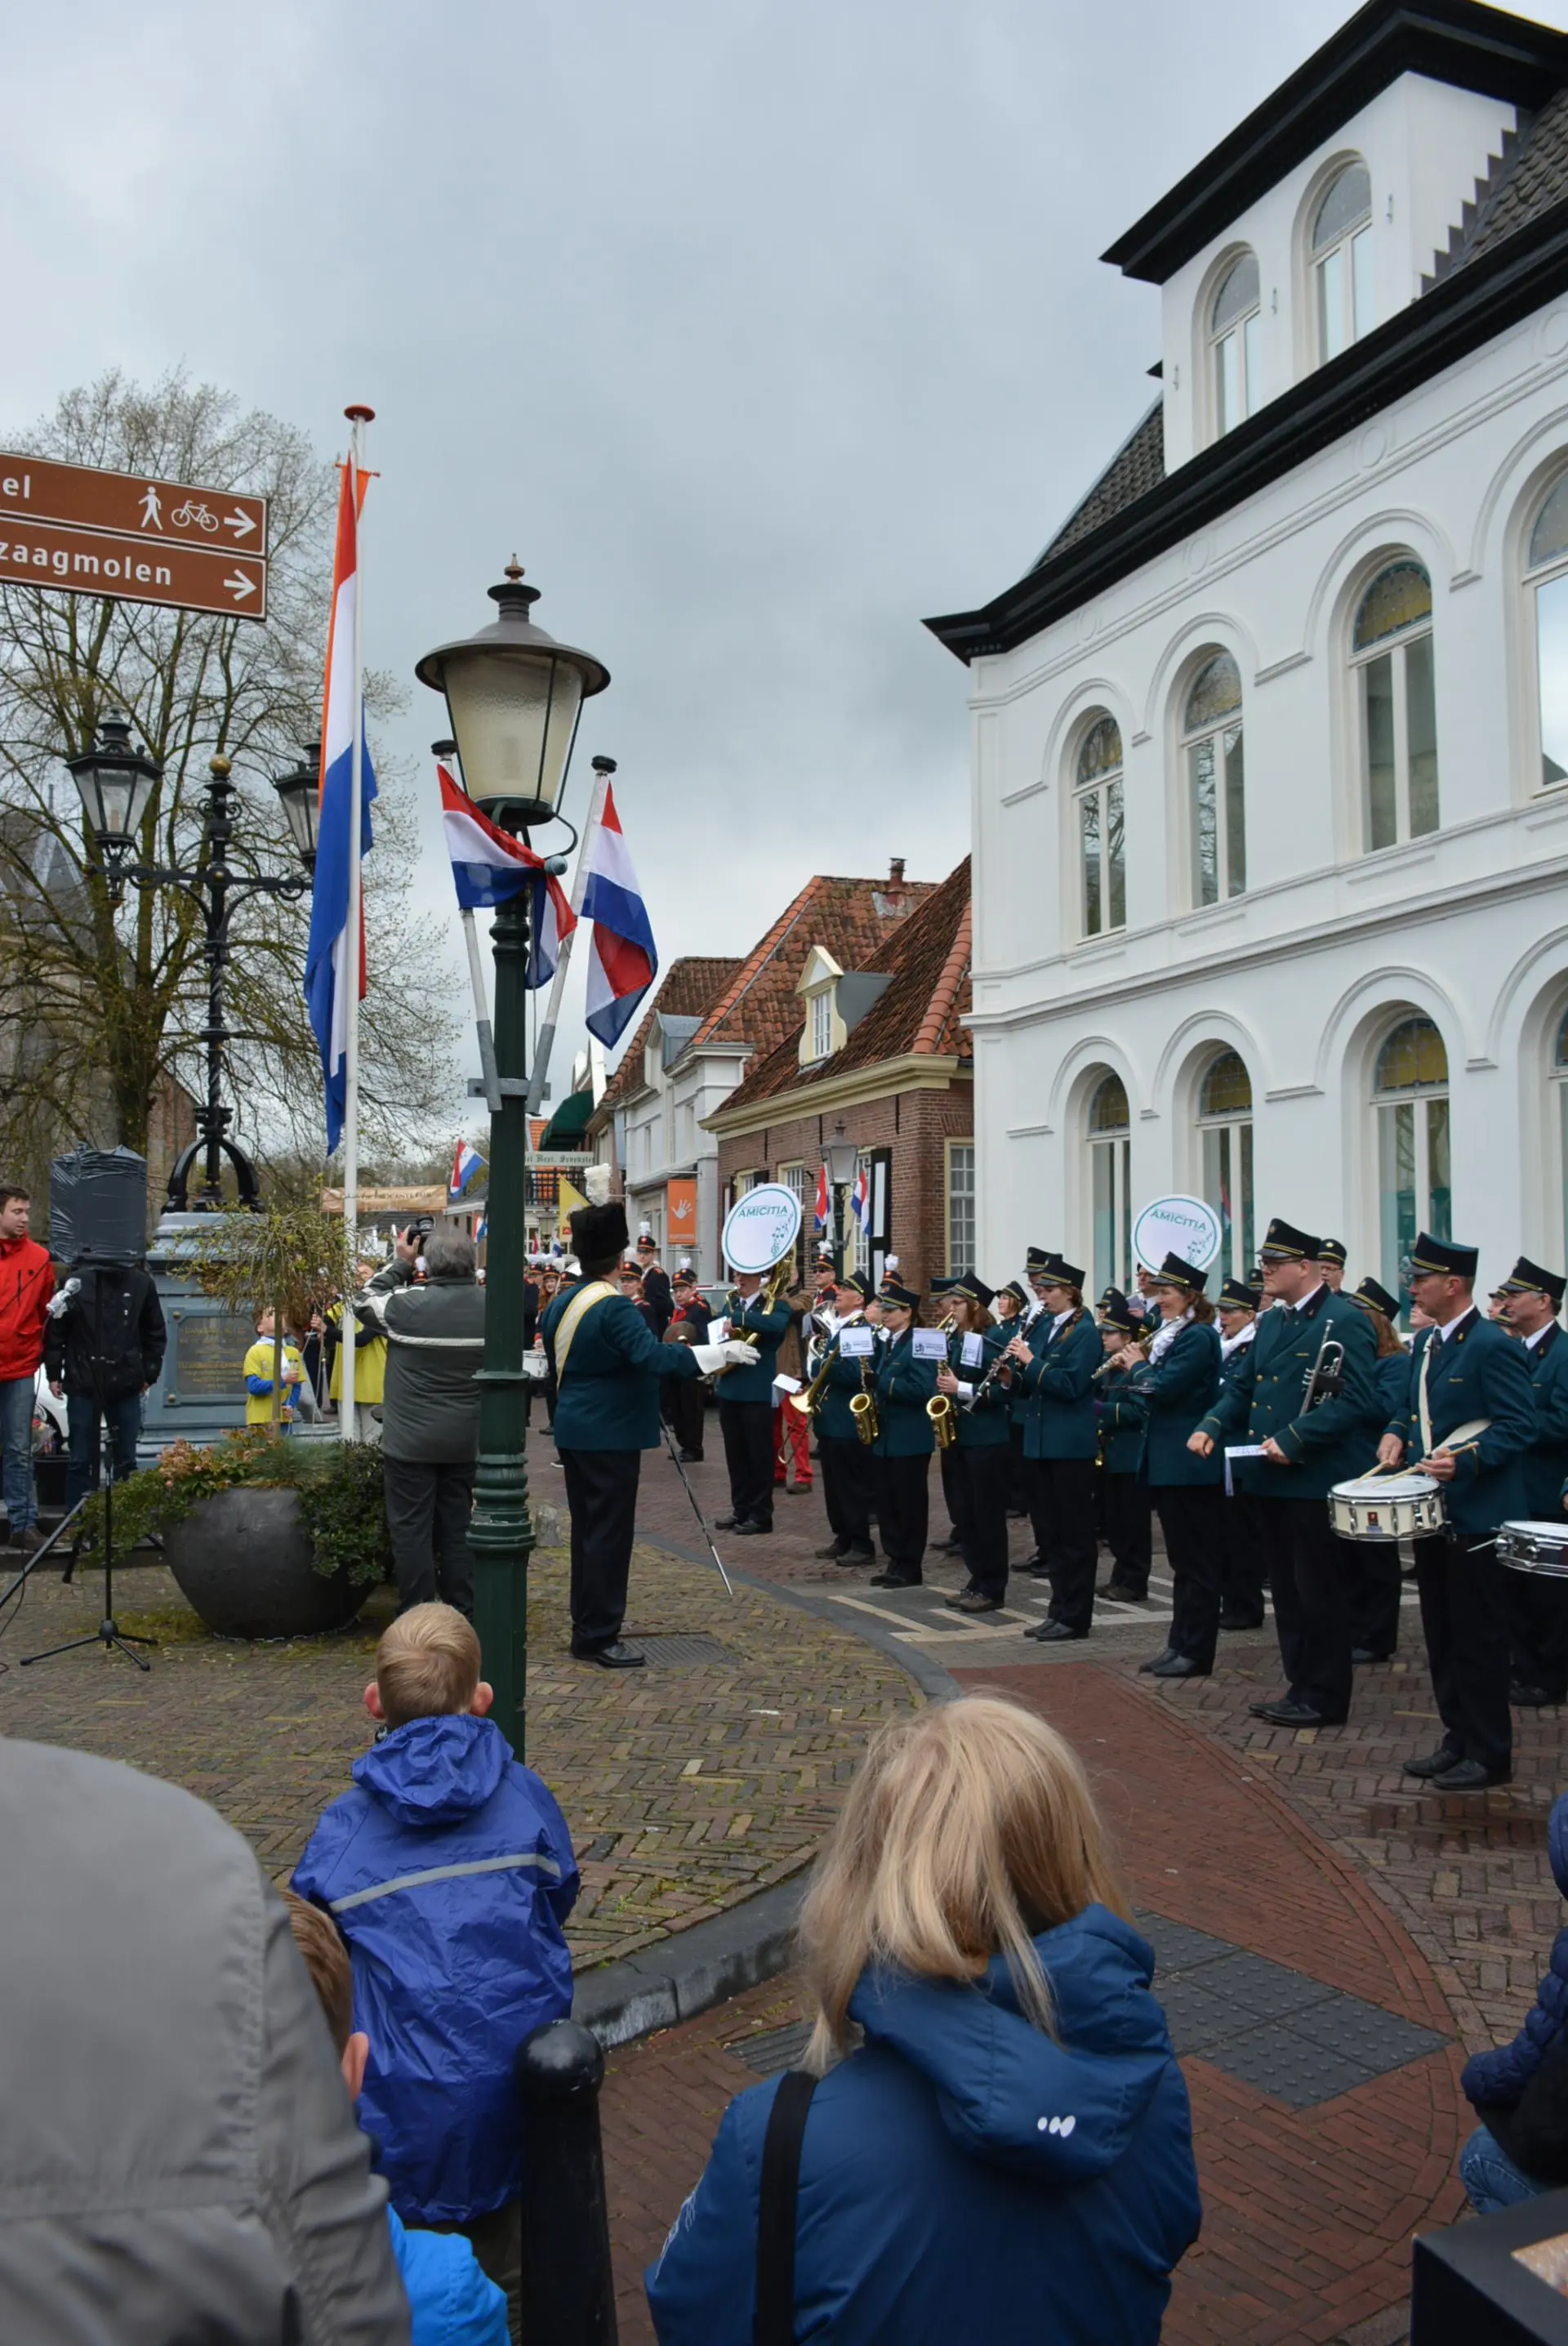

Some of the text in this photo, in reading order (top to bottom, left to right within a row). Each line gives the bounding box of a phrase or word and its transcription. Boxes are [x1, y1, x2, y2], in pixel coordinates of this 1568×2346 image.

[2, 475, 30, 498] el
[738, 1206, 787, 1217] AMICITIA
[1150, 1210, 1206, 1230] AMICITIA
